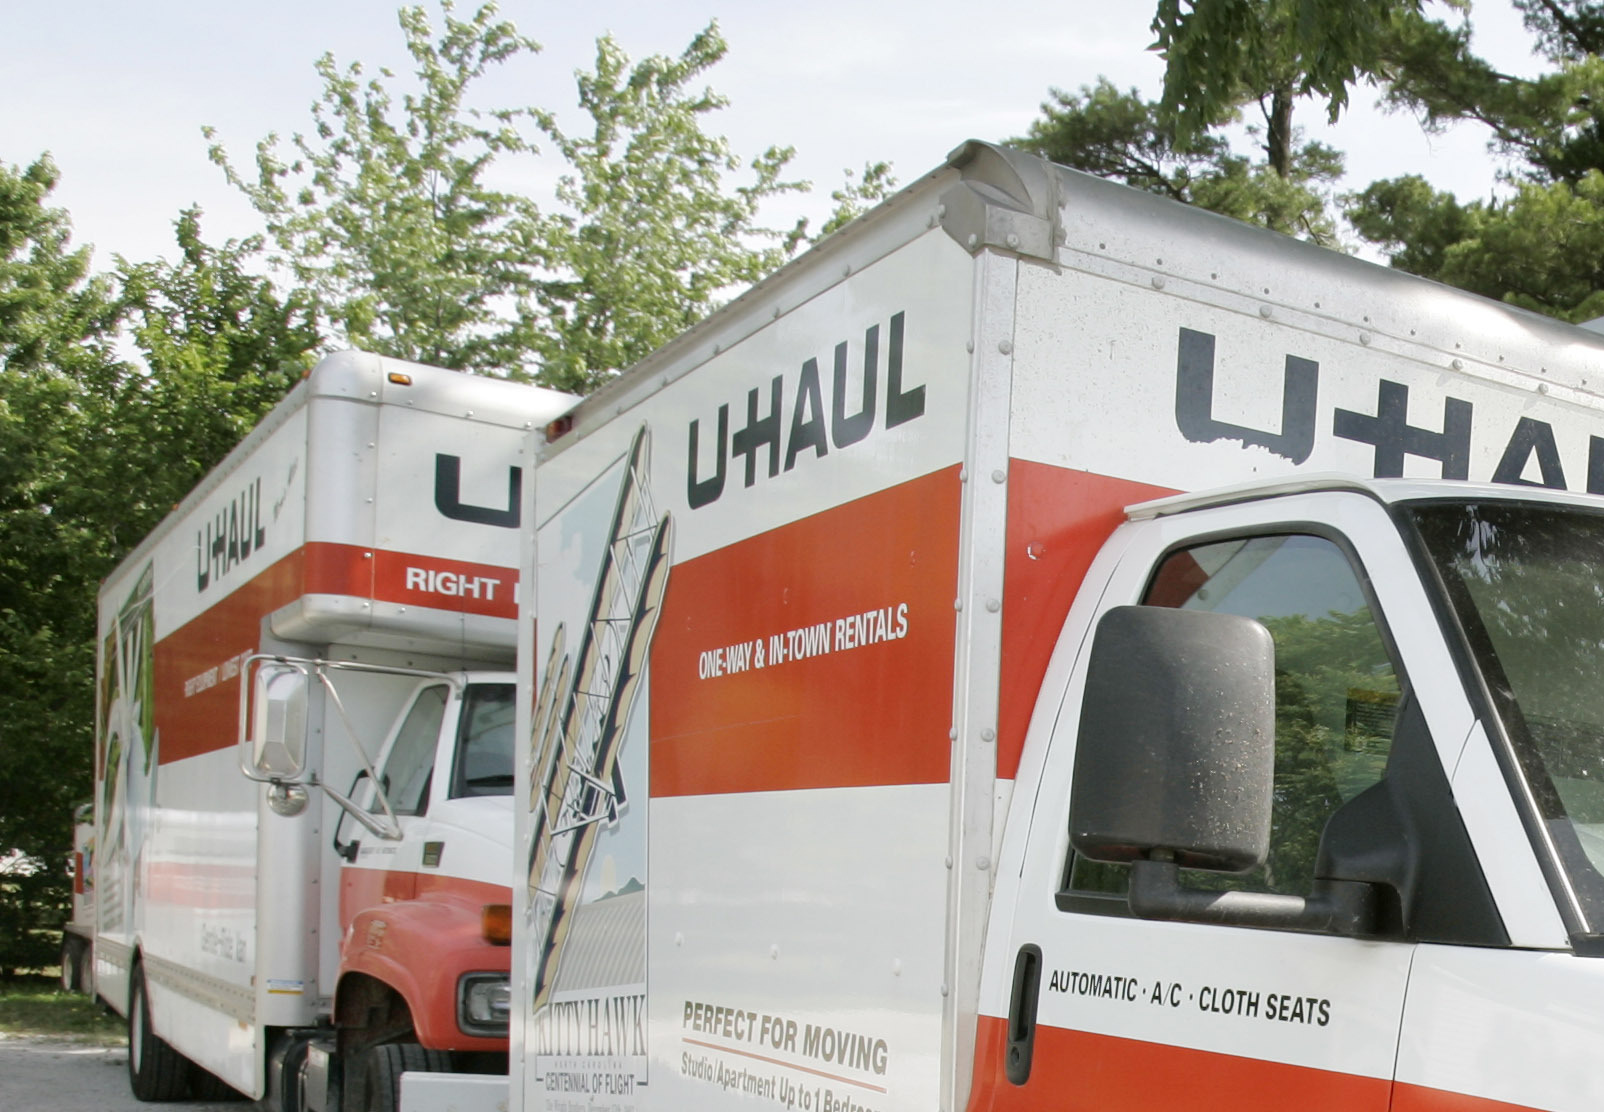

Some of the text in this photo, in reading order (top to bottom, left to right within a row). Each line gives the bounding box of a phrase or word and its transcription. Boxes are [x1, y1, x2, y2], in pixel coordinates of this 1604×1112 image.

[687, 311, 926, 510] U-HAUL
[406, 567, 501, 600] RIGHT
[699, 602, 909, 680] ONE-WAY & IN-TOWN RENTALS
[587, 994, 647, 1056] HAWK
[1048, 969, 1331, 1027] AUTOMATIC A/C CLOTH SEATS
[683, 1000, 888, 1076] PERFECT FOR MOVING
[545, 1071, 635, 1095] CENTENNIAL OF FLIGHT
[681, 1051, 776, 1101] Studio/Apartment
[779, 1076, 795, 1111] Up
[798, 1082, 811, 1111] to
